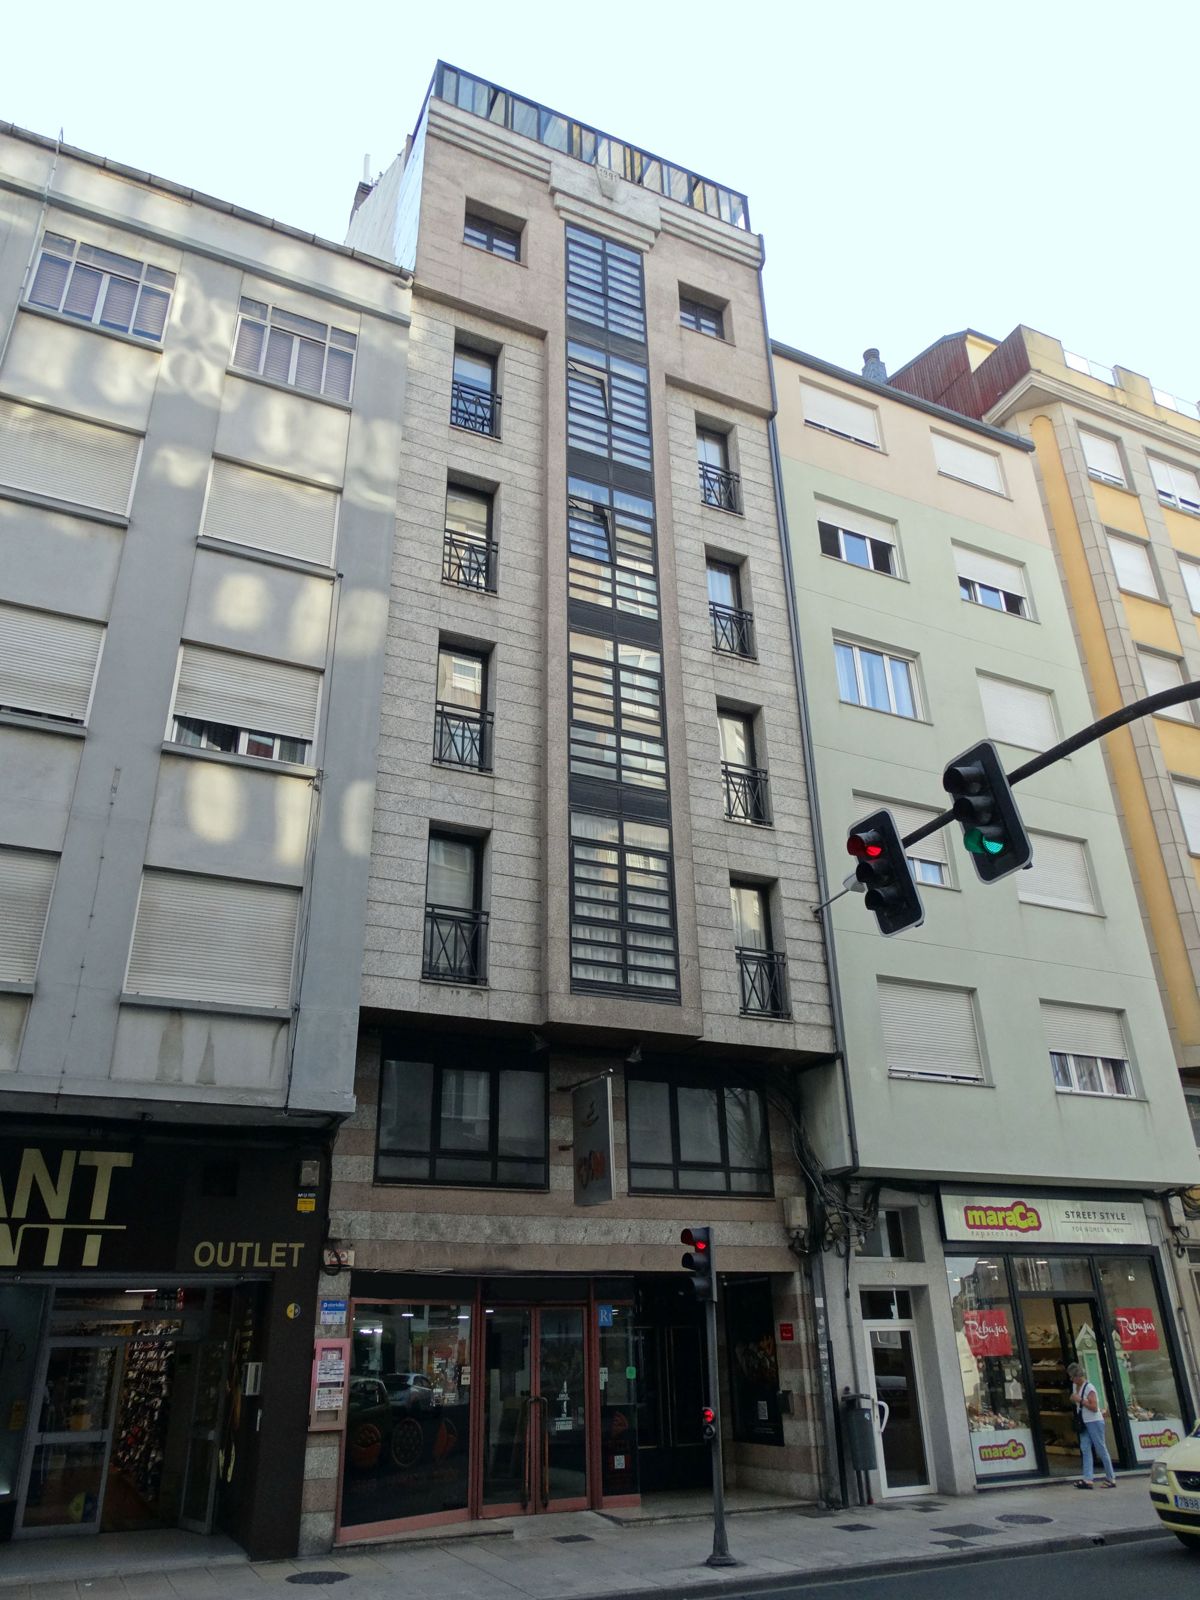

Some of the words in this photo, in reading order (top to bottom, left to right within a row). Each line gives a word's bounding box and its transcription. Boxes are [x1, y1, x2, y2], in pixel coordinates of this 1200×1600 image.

[1065, 1210, 1097, 1220] STREET
[1100, 1211, 1127, 1221] STYLE
[194, 1241, 305, 1267] OUTLET
[964, 1320, 1009, 1340] Rebajas
[1115, 1317, 1156, 1336] Rebajas
